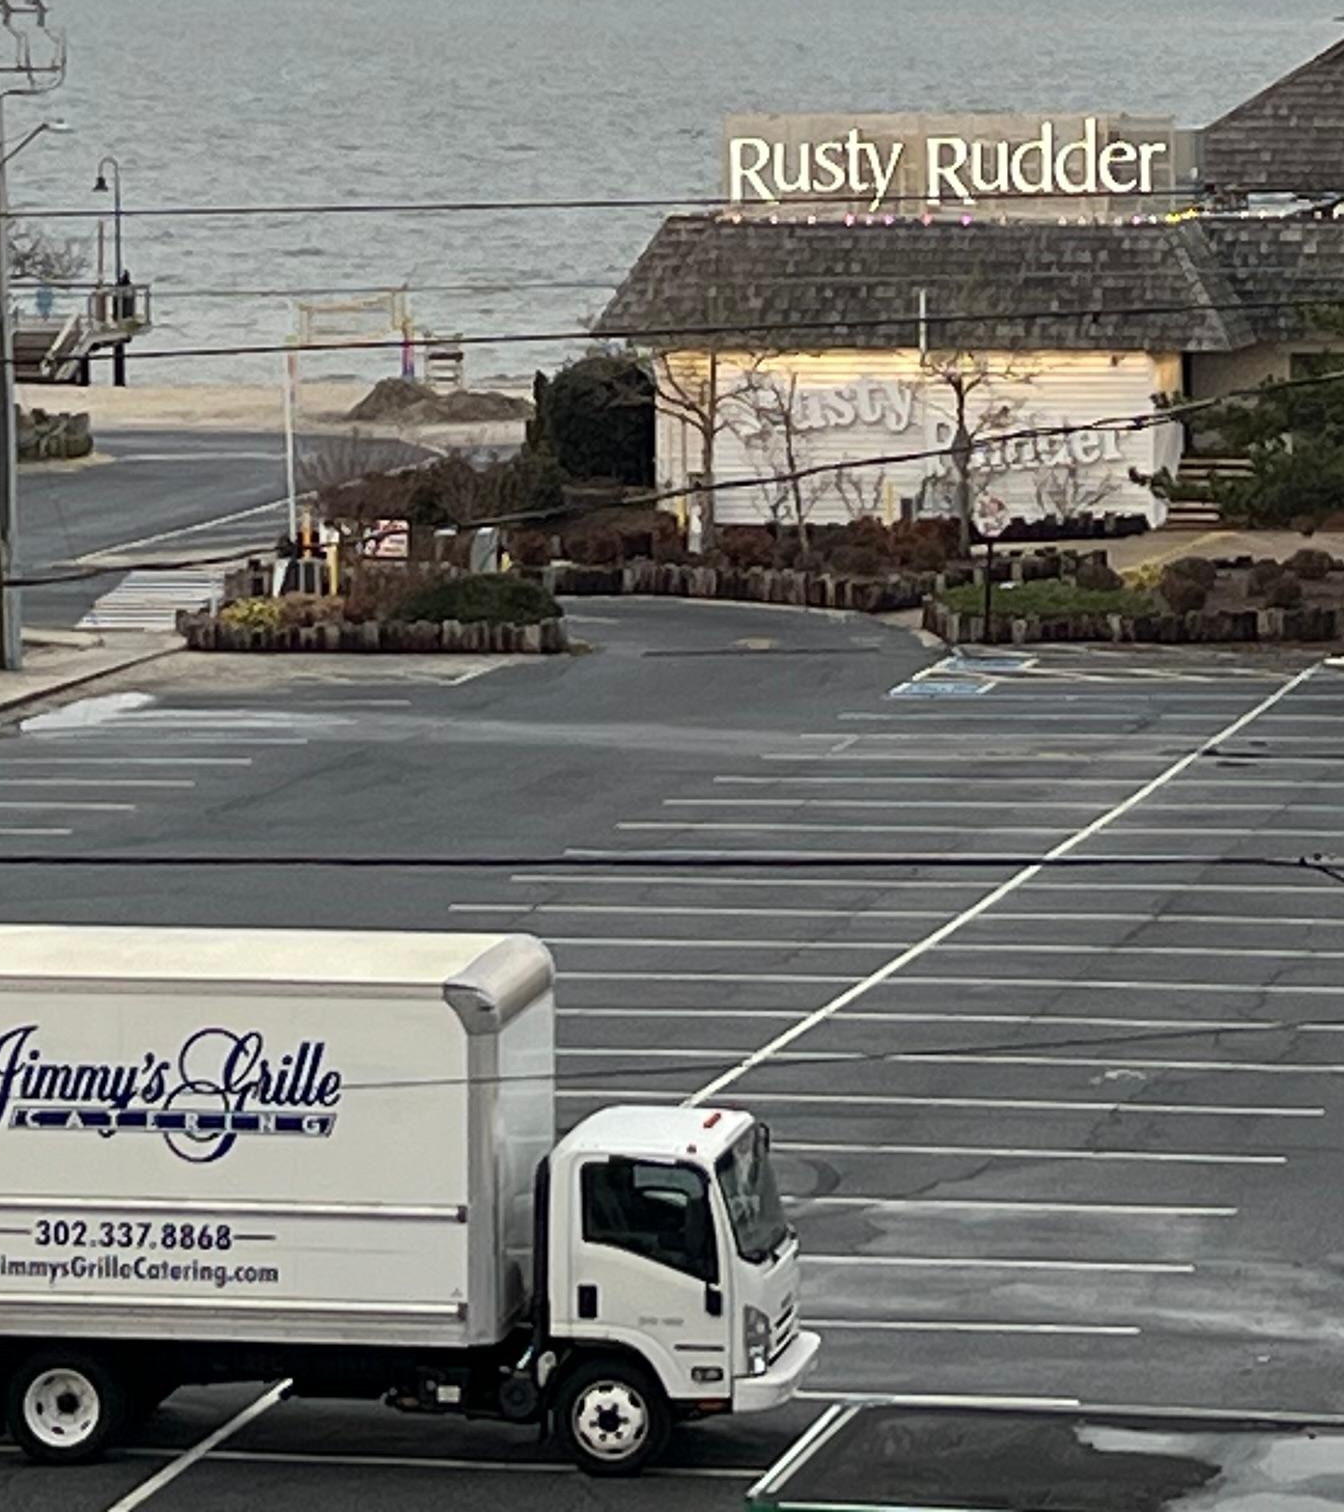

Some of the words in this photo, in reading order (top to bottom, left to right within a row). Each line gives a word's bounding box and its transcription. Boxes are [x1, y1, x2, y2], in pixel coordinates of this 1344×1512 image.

[728, 127, 905, 213] Rusty
[925, 117, 1167, 206] Rudder
[22, 1110, 322, 1134] CATERING
[163, 1027, 343, 1163] Grille
[34, 1219, 233, 1251] 302.337.8868
